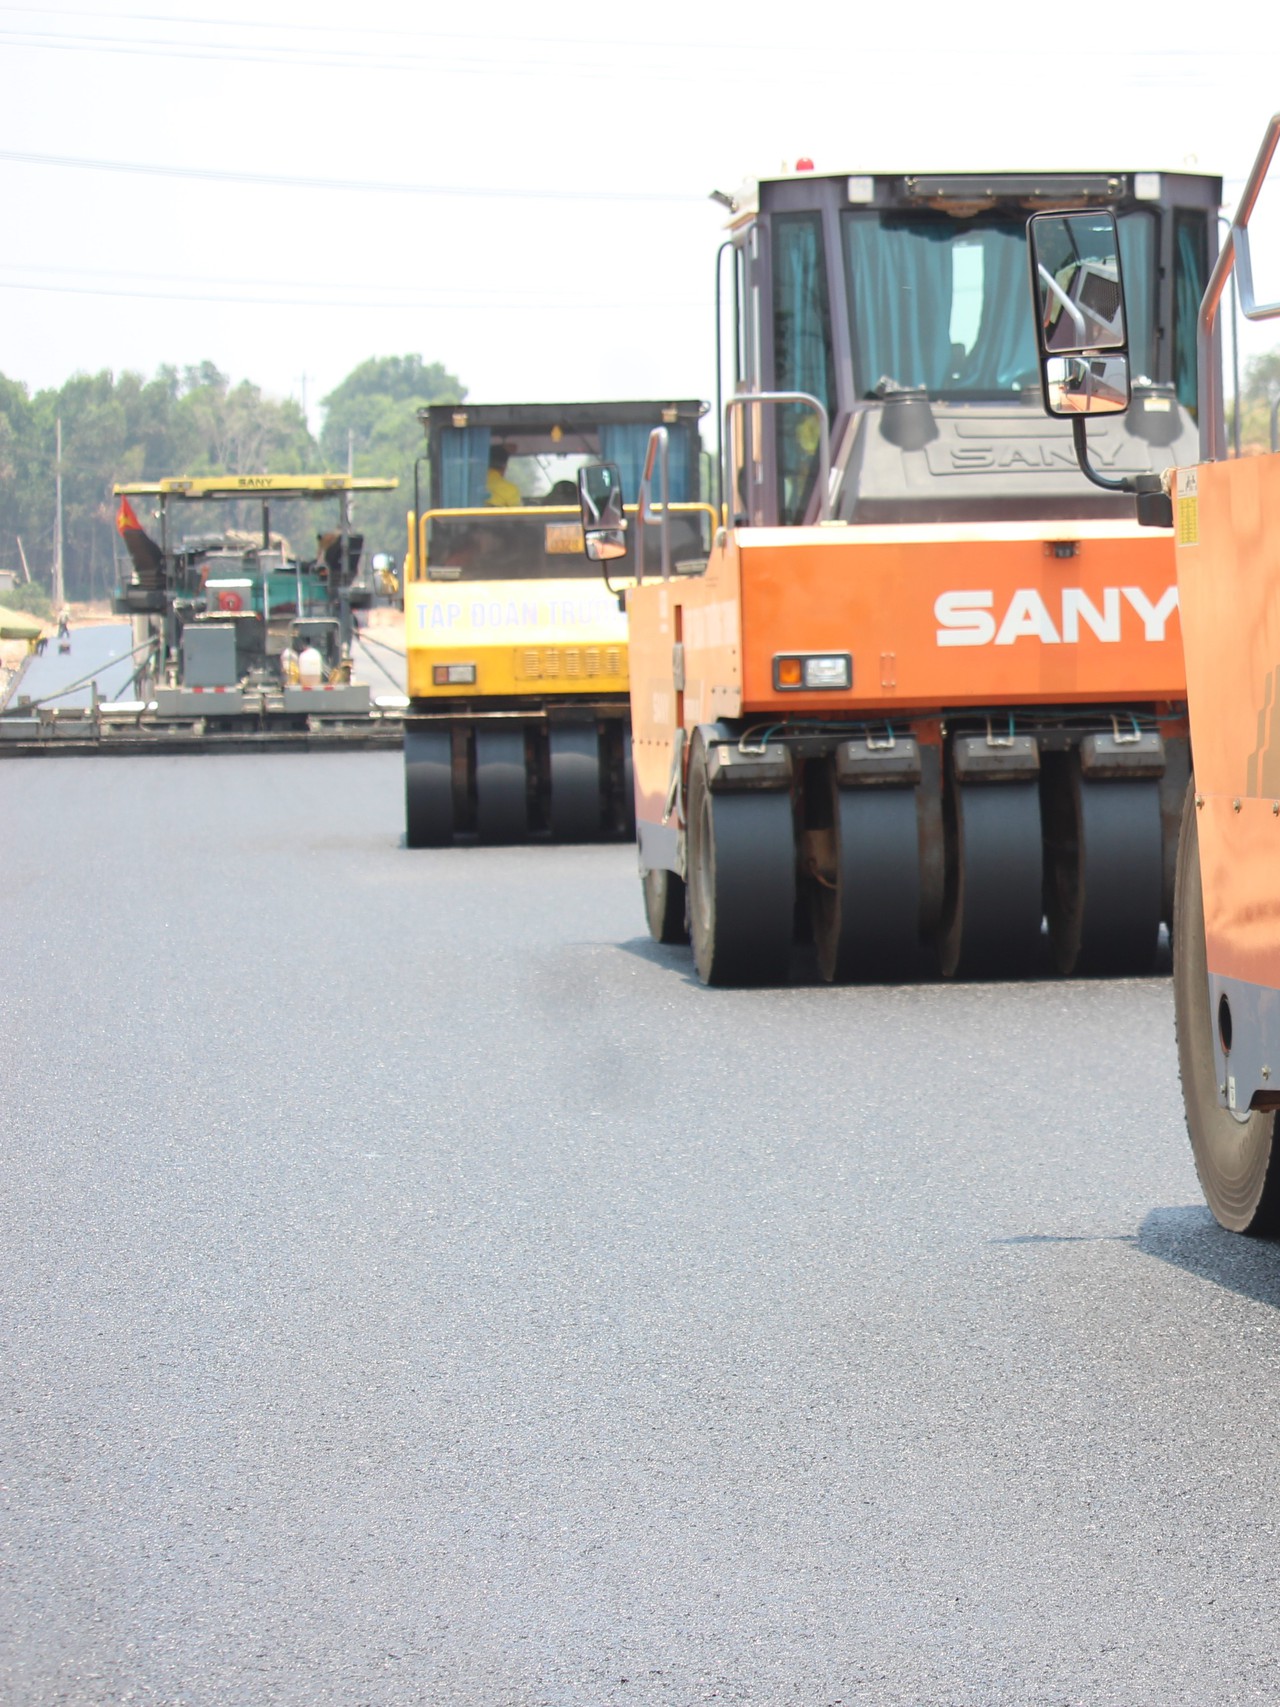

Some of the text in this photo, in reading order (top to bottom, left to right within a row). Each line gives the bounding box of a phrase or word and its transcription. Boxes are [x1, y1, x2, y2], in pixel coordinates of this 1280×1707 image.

[950, 442, 1124, 469] SANY
[238, 478, 273, 488] SANY
[933, 585, 1180, 647] SANY
